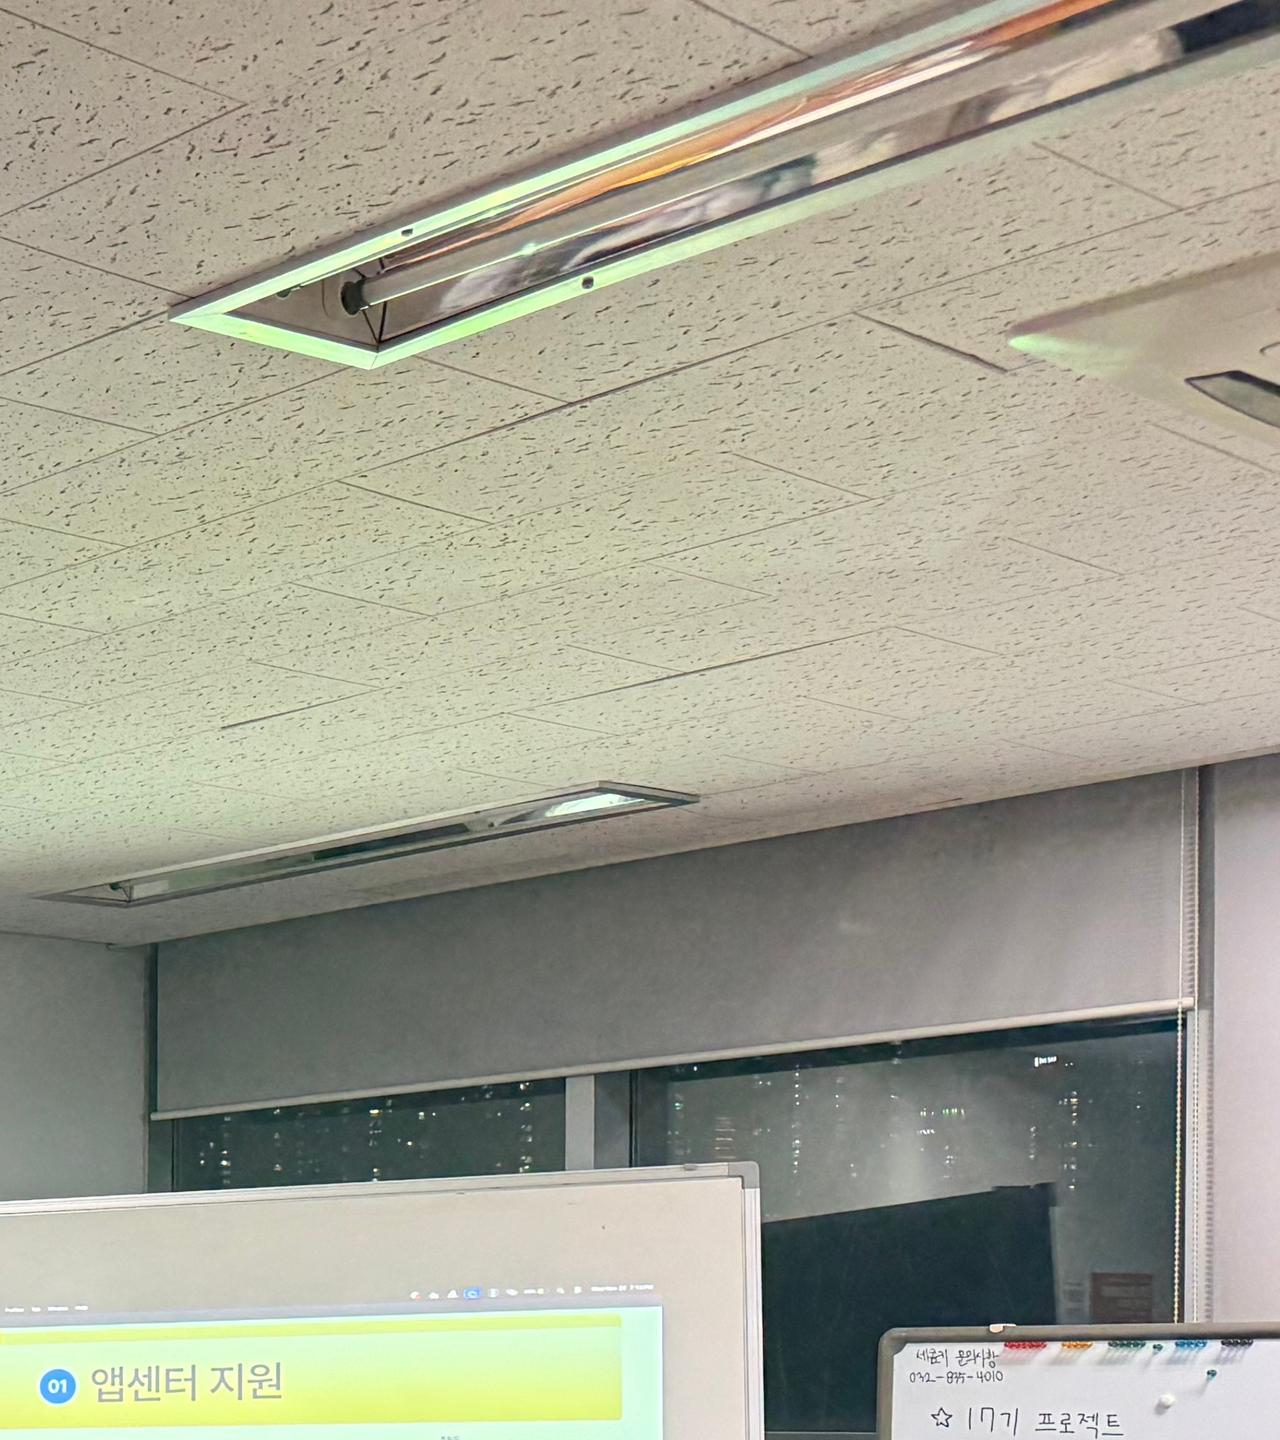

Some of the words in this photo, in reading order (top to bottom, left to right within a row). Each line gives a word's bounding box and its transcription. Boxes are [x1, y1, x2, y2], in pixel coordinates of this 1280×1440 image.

[955, 1348, 999, 1368] 문의사항
[47, 1379, 68, 1395] 01
[91, 1364, 197, 1403] 앱센터
[210, 1362, 283, 1400] 지원
[968, 1407, 1019, 1436] 17기
[1035, 1412, 1124, 1439] 프로젝트
